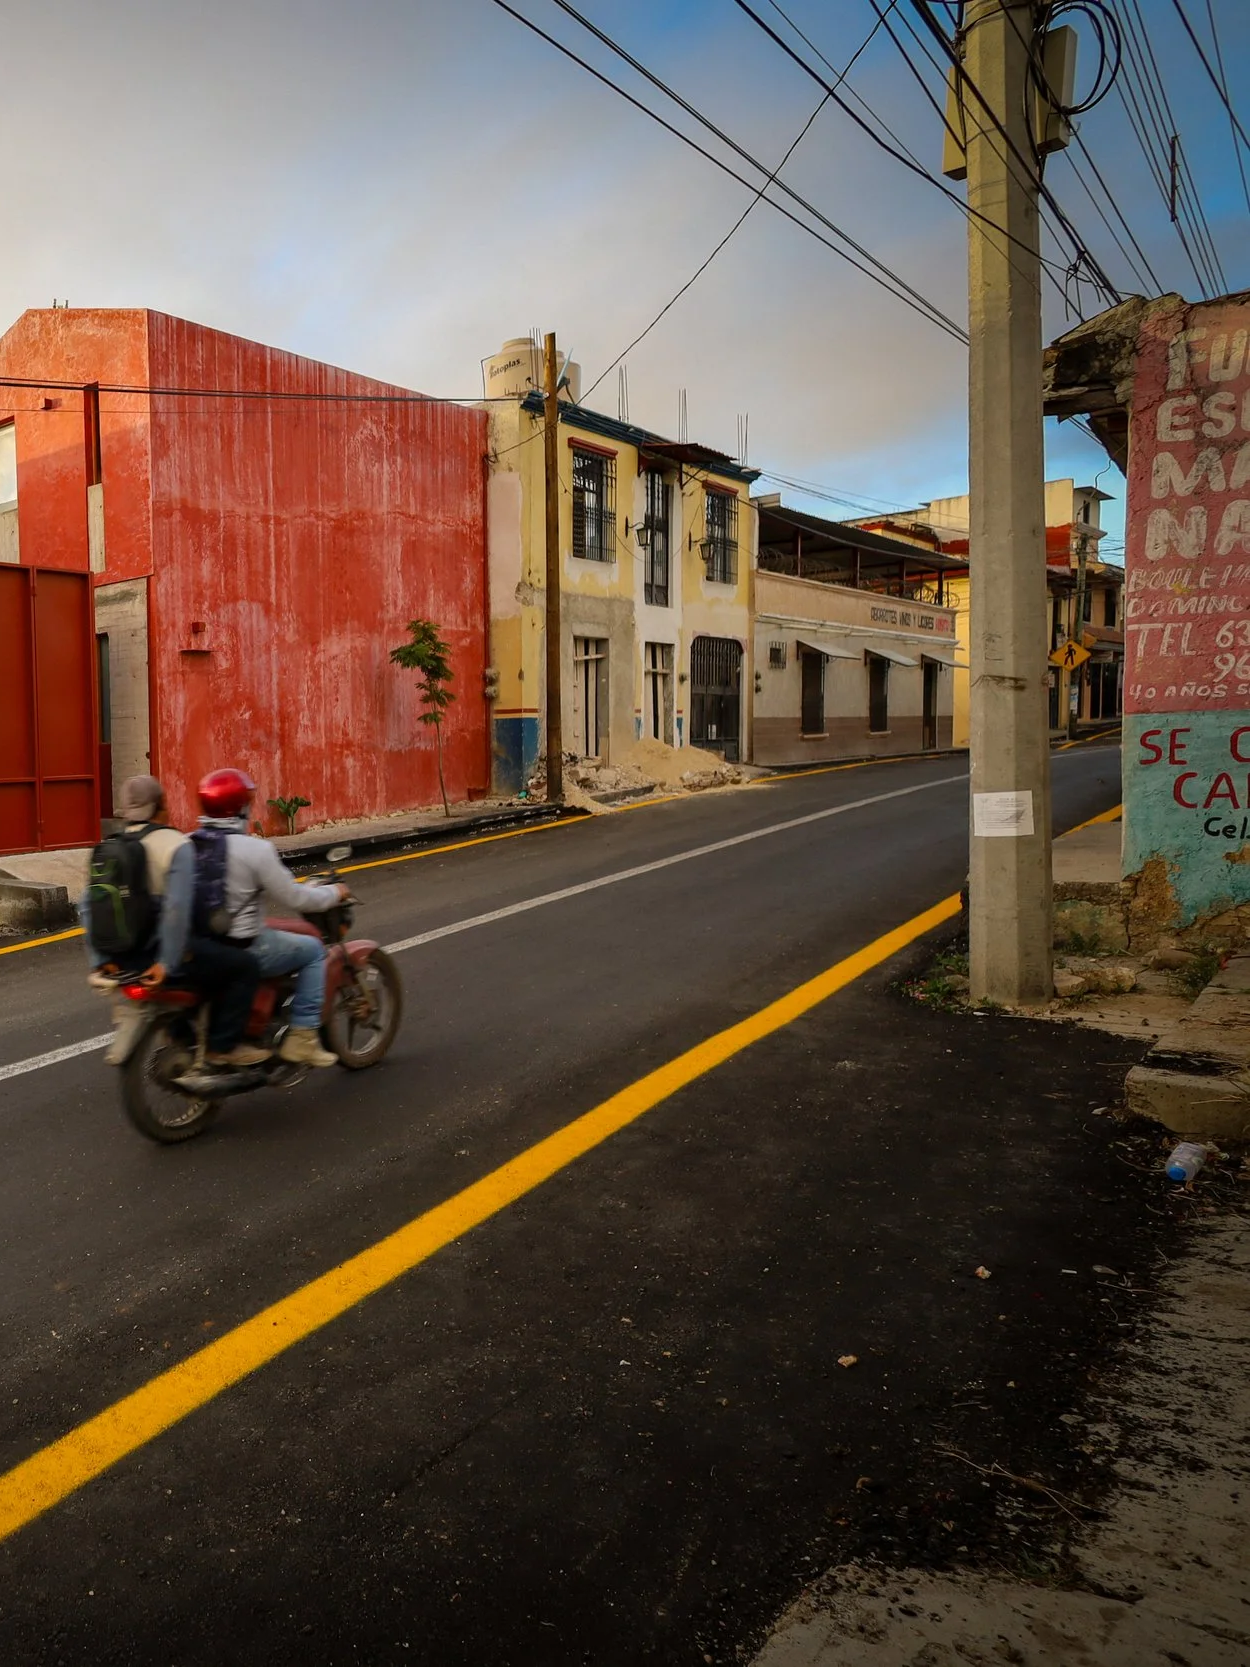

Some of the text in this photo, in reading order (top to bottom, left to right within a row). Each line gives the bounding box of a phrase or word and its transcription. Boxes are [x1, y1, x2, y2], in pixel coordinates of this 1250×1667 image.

[1167, 328, 1250, 391] FU
[1126, 621, 1197, 658] TEL
[1164, 682, 1228, 698] AÑOS
[1235, 683, 1250, 695] S
[1139, 727, 1191, 766] SE
[1173, 771, 1250, 810] CA
